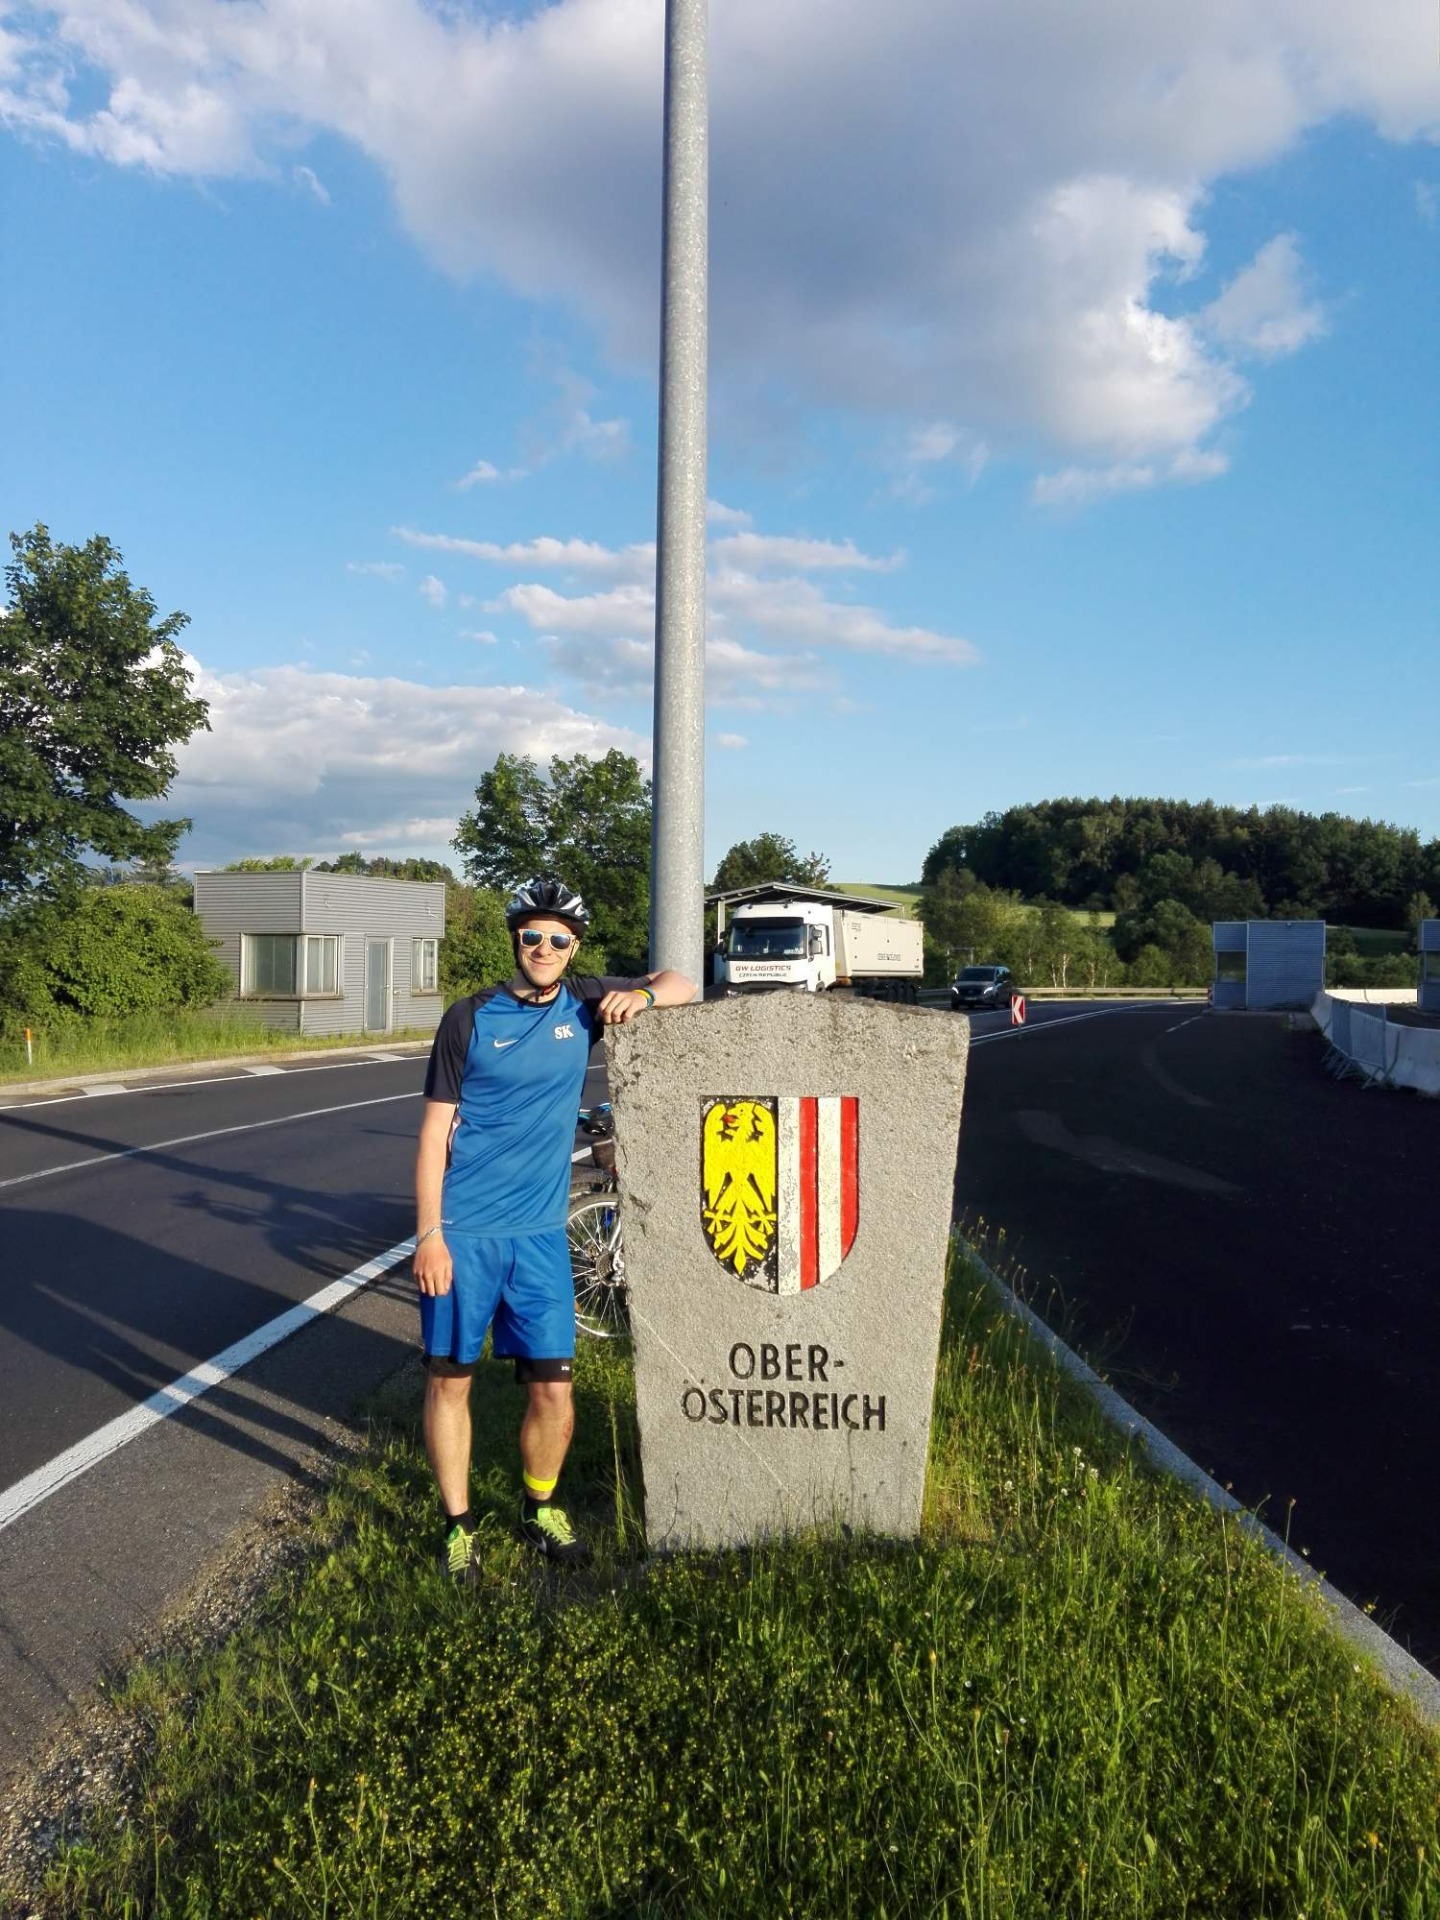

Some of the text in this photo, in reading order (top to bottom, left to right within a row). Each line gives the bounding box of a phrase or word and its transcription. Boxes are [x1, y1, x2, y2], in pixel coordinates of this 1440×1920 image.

[554, 1024, 574, 1041] SK
[728, 1342, 845, 1382] OBER-
[680, 1378, 886, 1431] ÖSTERREICH
